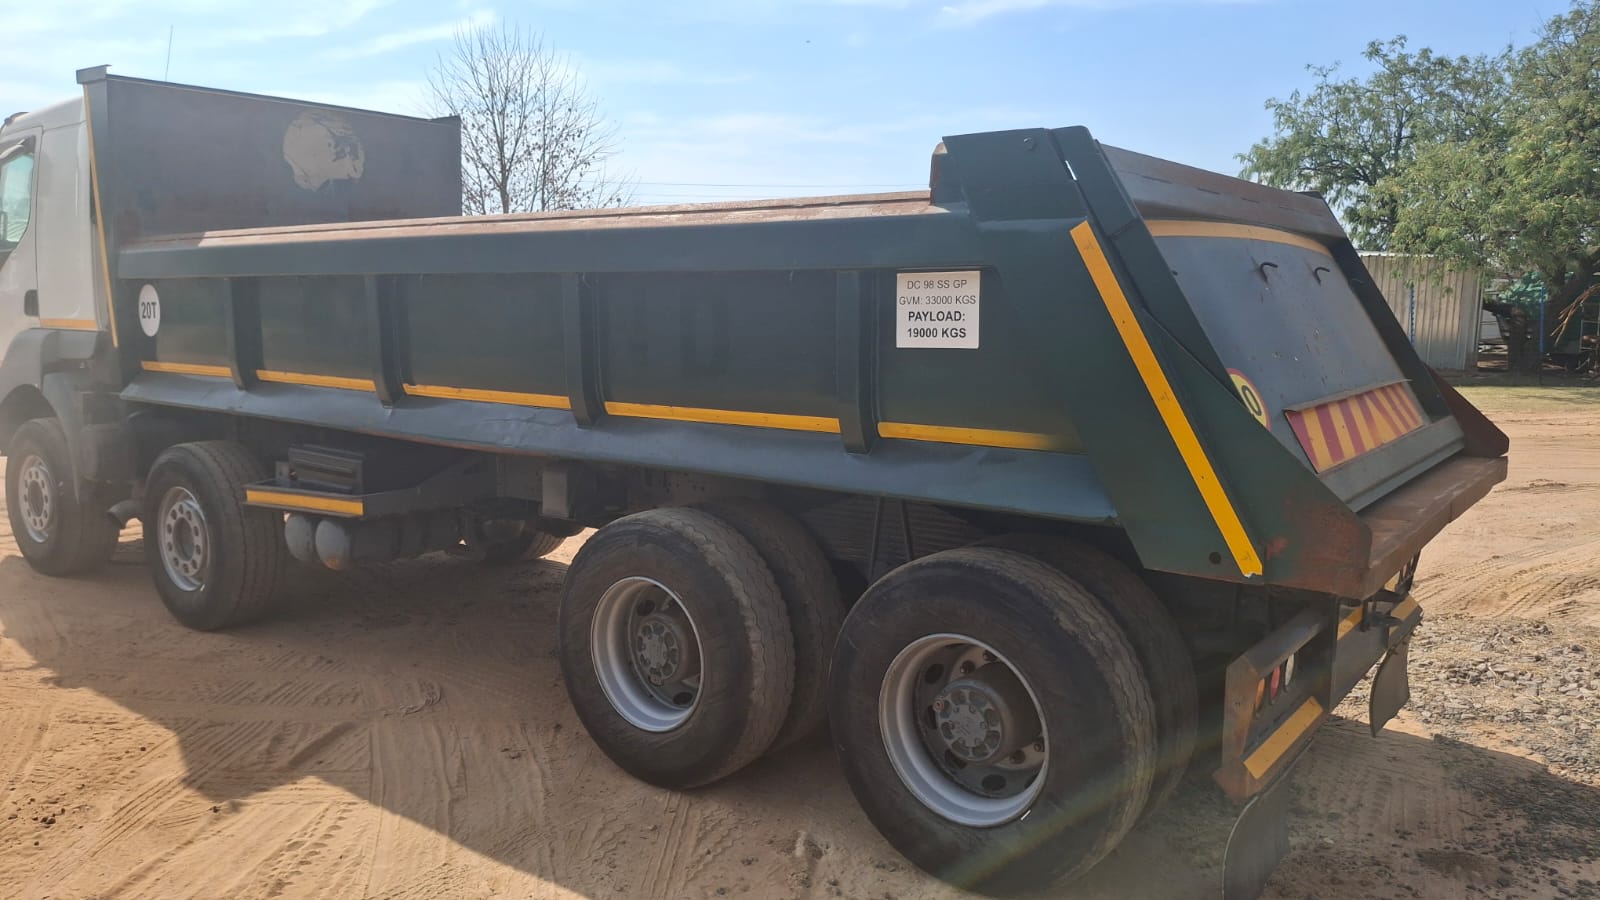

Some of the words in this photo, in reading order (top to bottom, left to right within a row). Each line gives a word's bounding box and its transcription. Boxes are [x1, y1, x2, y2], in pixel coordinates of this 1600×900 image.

[907, 280, 921, 289] DC
[923, 280, 934, 289] 98
[937, 280, 950, 289] SS
[953, 279, 967, 288] GP
[899, 296, 923, 305] GVM:
[925, 295, 953, 305] 33000
[955, 295, 976, 305] KGS
[141, 302, 157, 319] 20T
[908, 310, 966, 322] PAYLOAD:
[907, 327, 938, 338] 19000
[941, 327, 967, 338] KGS
